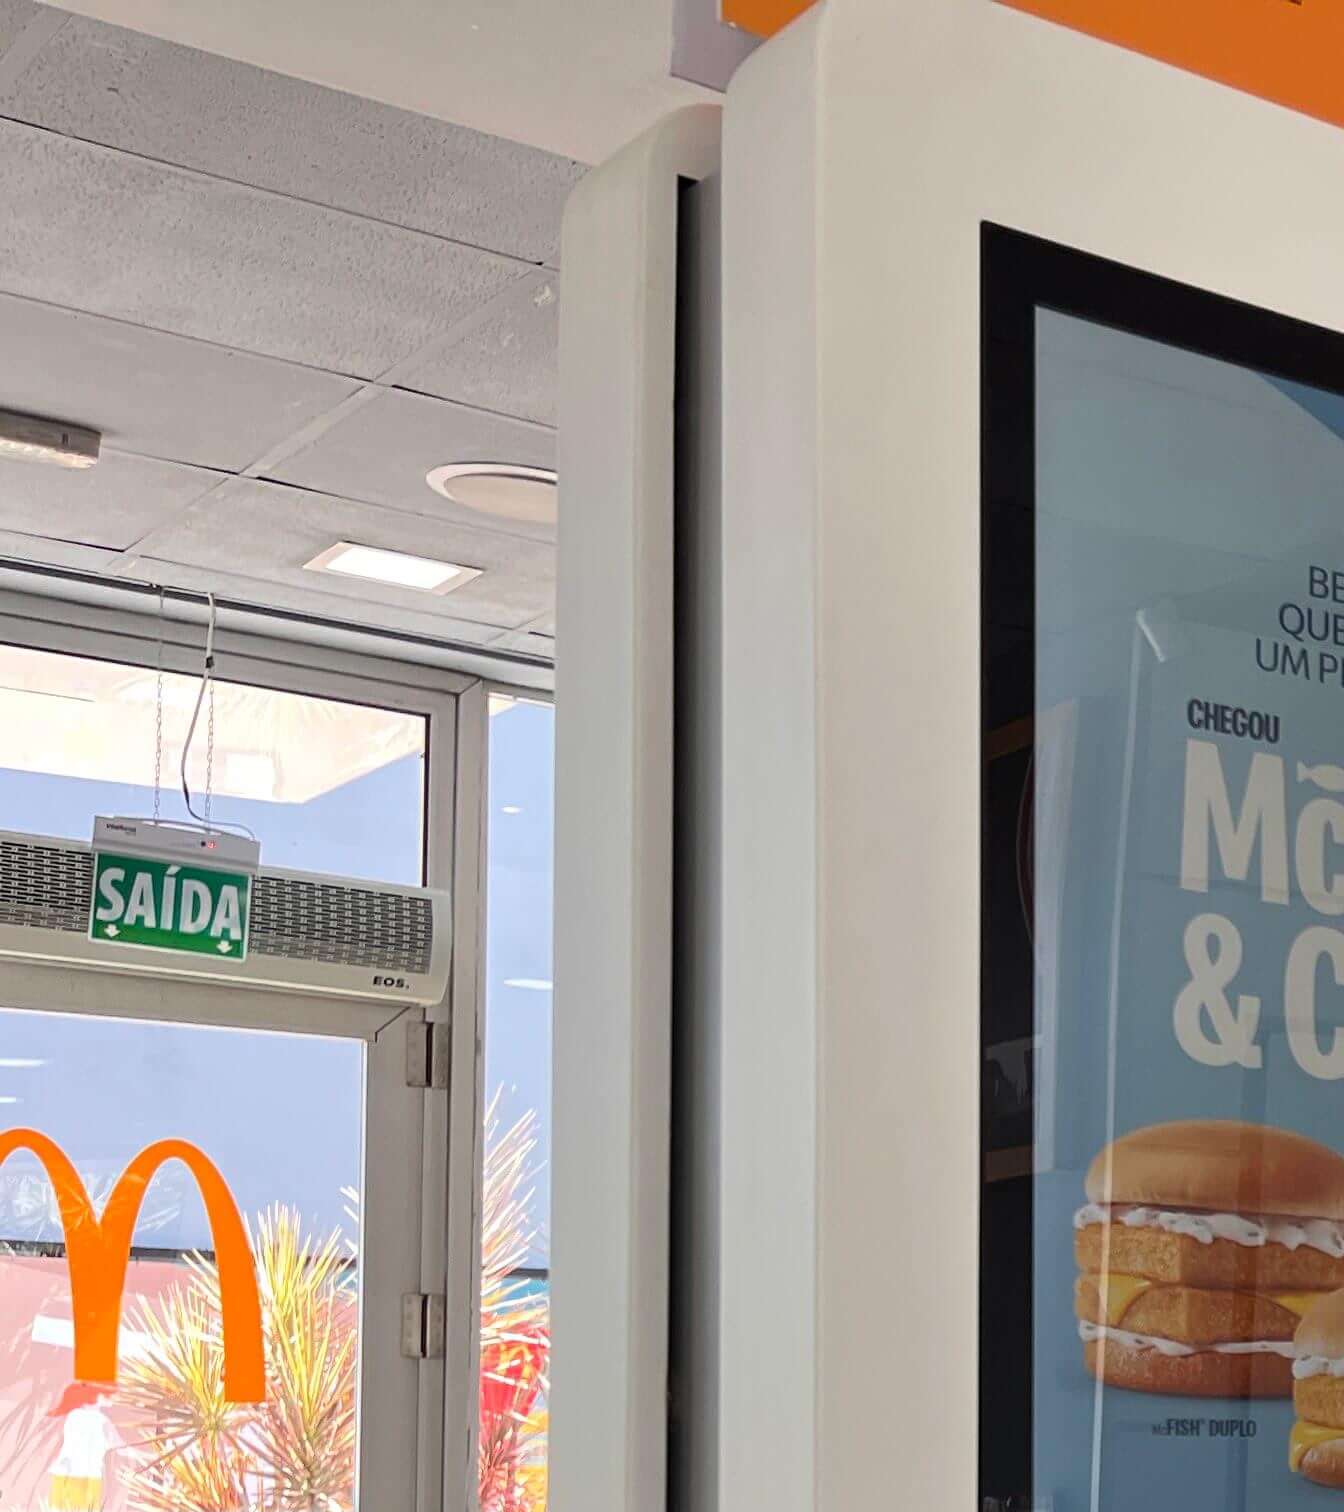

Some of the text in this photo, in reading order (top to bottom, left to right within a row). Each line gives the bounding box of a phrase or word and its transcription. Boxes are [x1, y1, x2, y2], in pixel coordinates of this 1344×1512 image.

[1256, 637, 1310, 680] UM
[1187, 699, 1281, 744] CHEGOU
[96, 865, 241, 940] SAÍDA
[1172, 913, 1263, 1070] &
[1208, 1418, 1257, 1438] DUPLO
